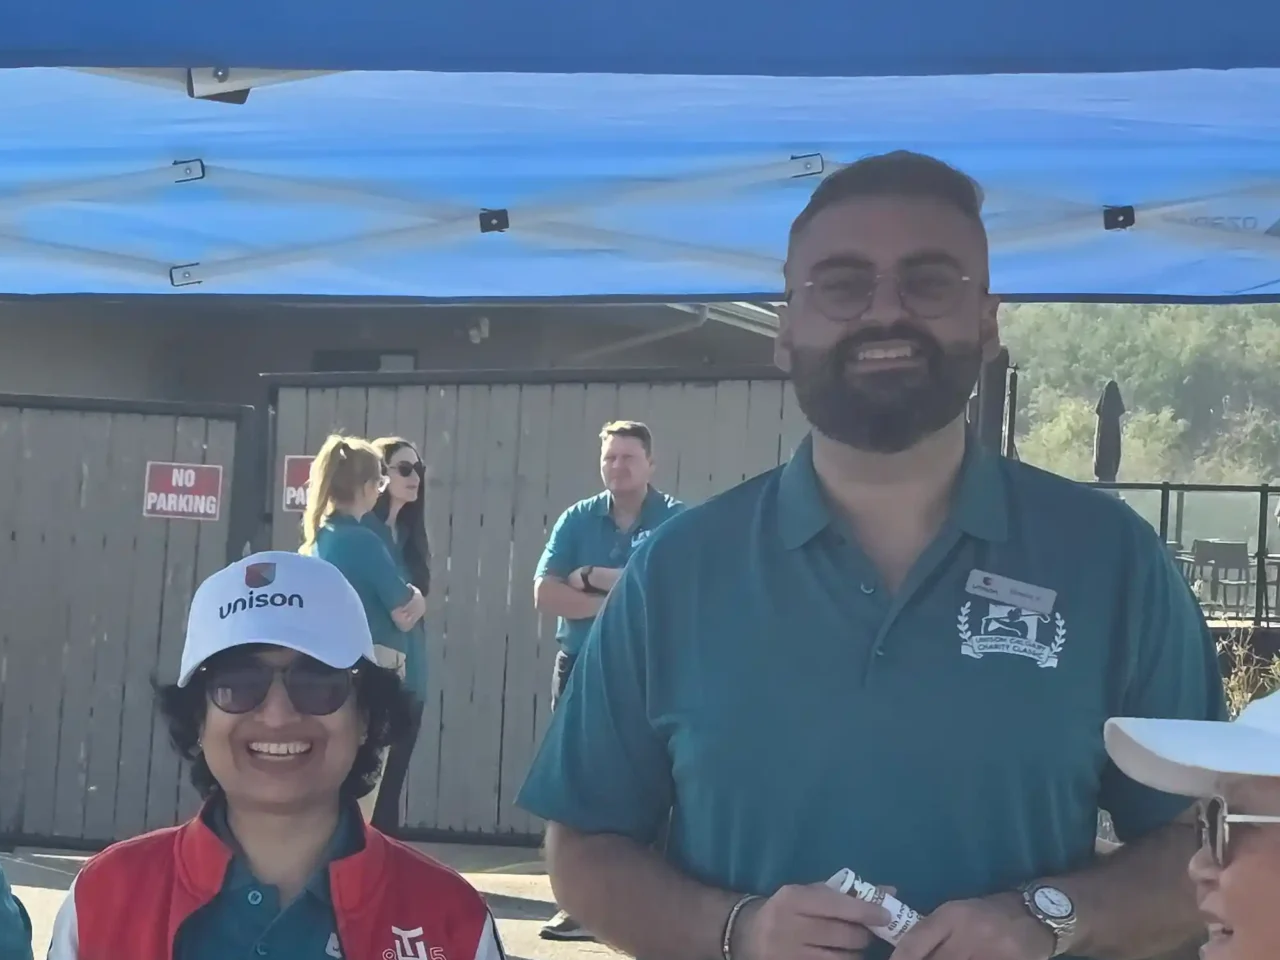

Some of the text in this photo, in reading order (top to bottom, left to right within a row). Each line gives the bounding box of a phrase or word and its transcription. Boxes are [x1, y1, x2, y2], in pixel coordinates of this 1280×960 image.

[171, 468, 196, 487] NO
[146, 492, 217, 515] PARKING
[219, 590, 304, 620] unison
